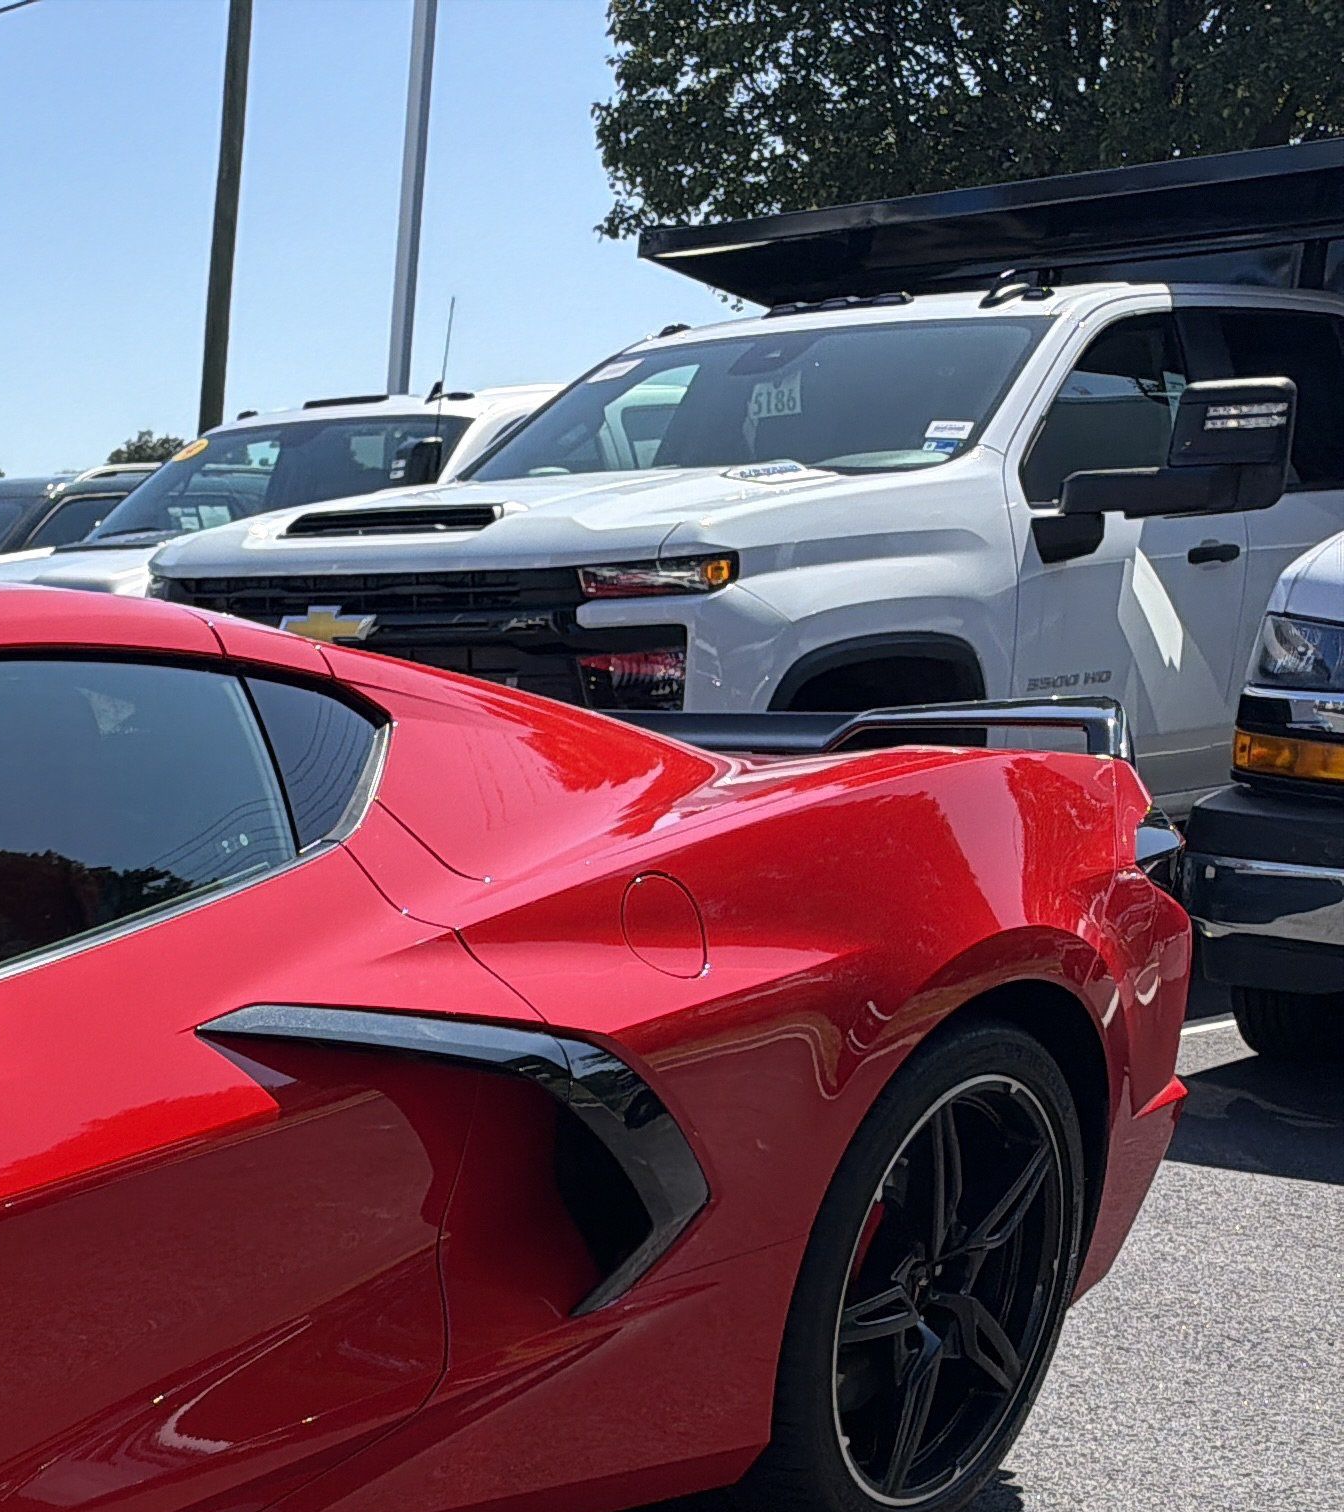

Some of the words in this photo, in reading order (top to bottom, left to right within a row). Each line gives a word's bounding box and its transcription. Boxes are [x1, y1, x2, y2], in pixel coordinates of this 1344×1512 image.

[753, 389, 797, 415] 5186
[1026, 676, 1080, 691] 3500
[1083, 670, 1112, 686] HD
